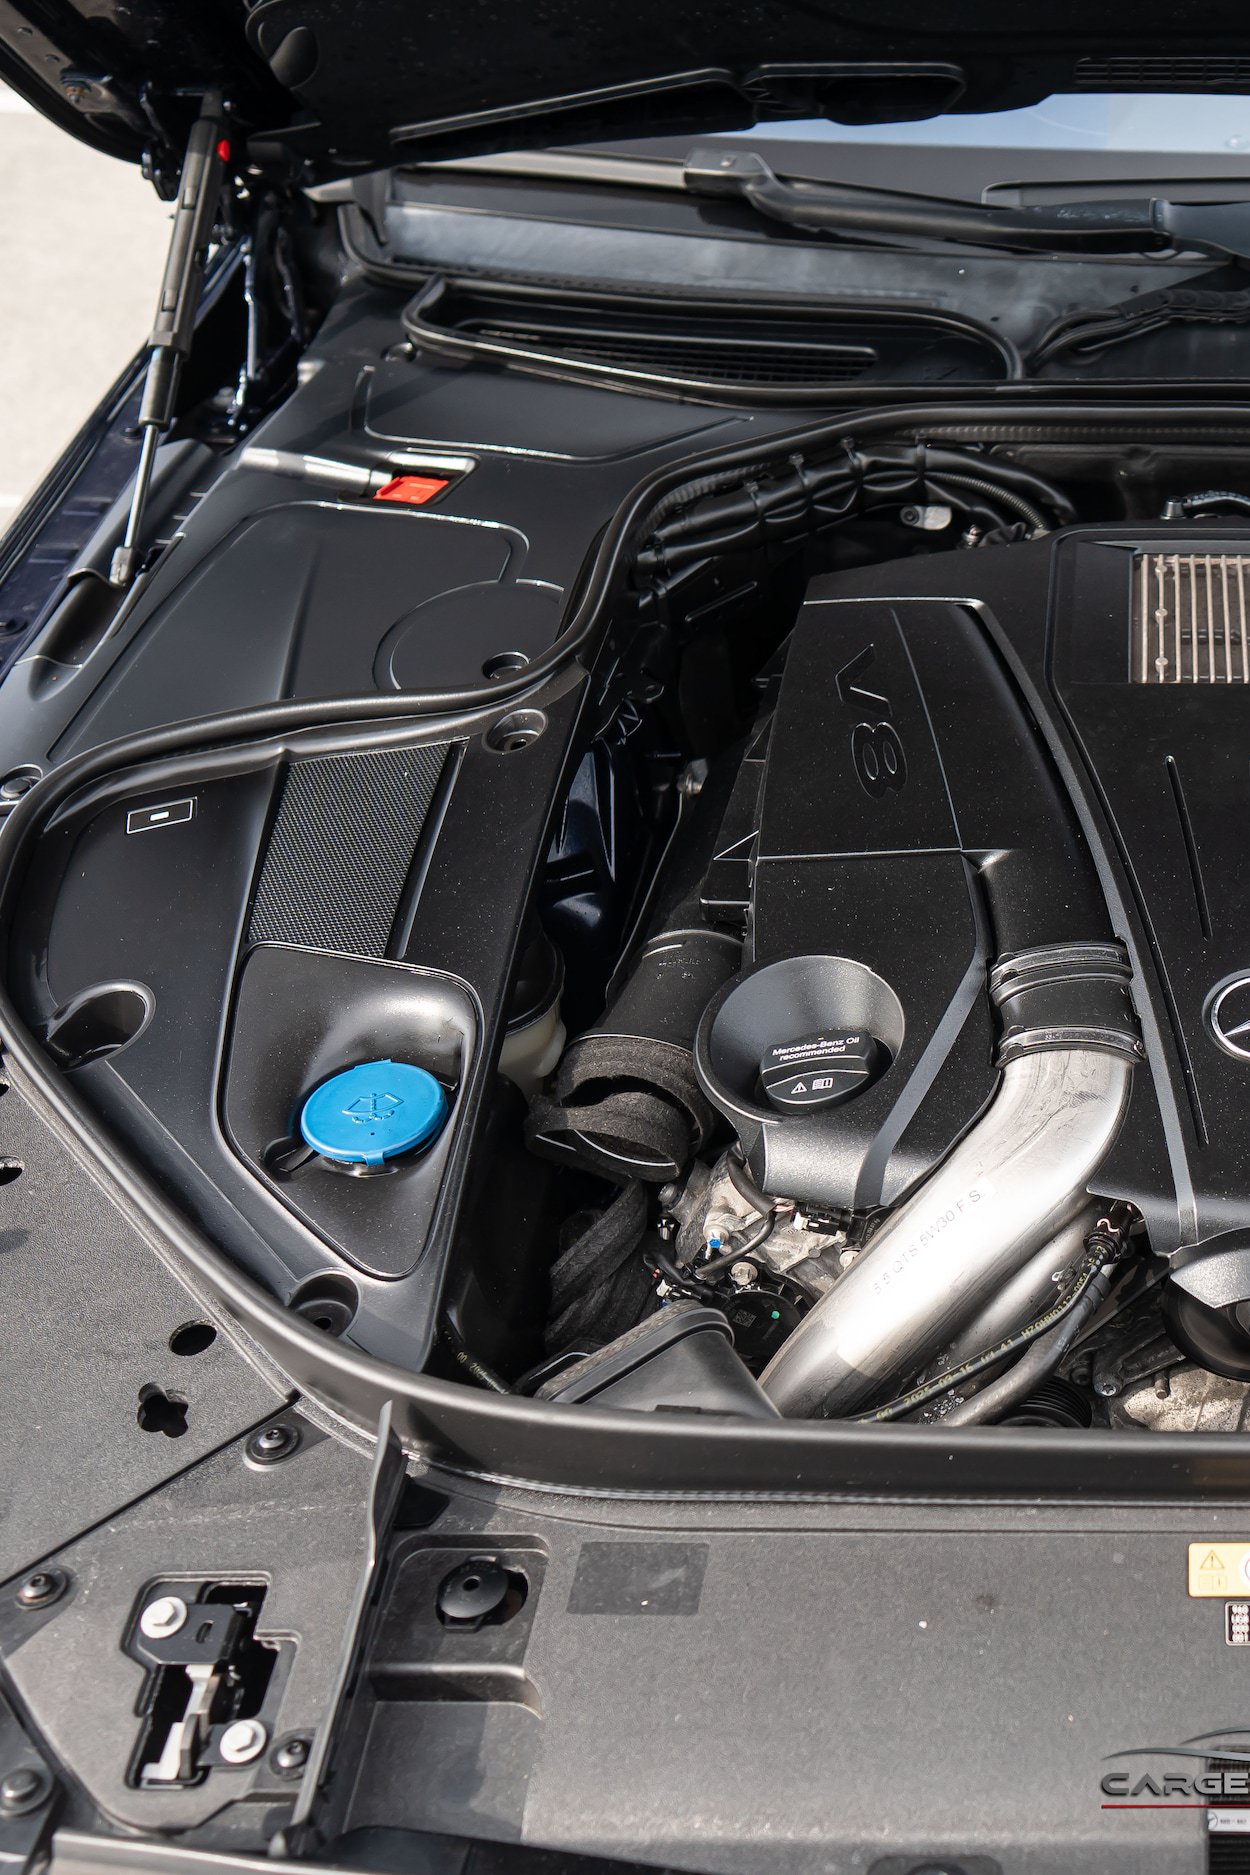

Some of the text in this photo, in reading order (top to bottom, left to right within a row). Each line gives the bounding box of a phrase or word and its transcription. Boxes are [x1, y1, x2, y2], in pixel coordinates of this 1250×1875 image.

[836, 643, 908, 799] V8
[772, 1036, 860, 1056] Mercedes-Benz Oil
[779, 1045, 846, 1061] recommended
